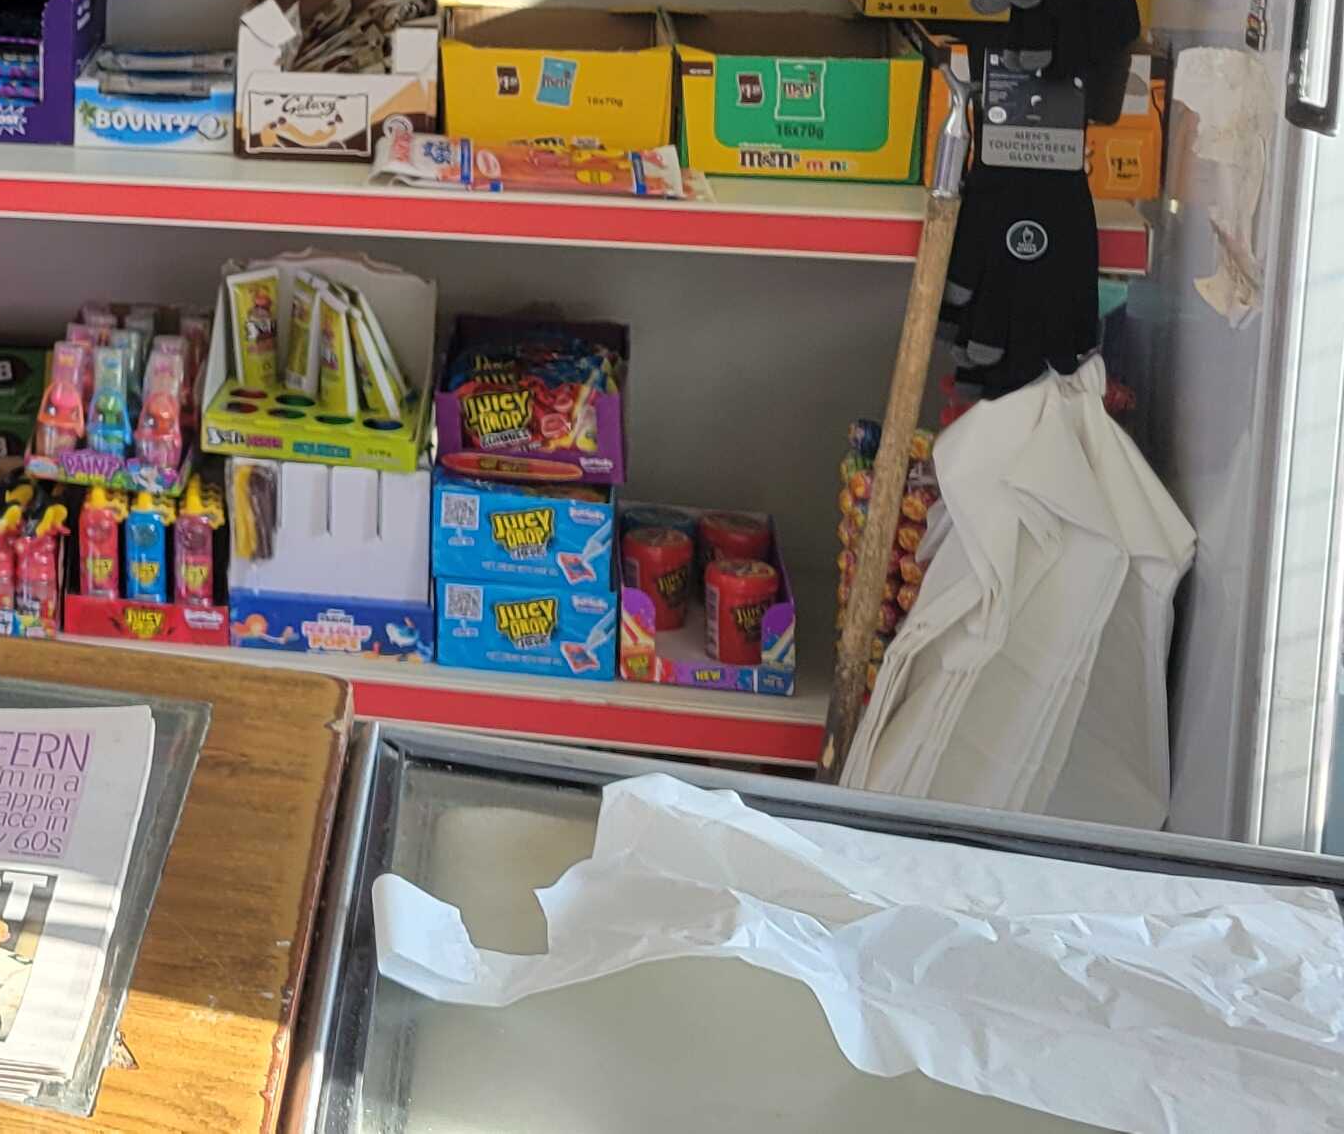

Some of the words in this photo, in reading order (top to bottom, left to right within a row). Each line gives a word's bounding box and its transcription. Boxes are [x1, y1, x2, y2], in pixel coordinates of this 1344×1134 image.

[94, 110, 198, 132] BOUNTY
[463, 390, 532, 423] JUICY
[491, 508, 555, 534] JUICY
[32, 770, 56, 791] in
[66, 776, 80, 792] a
[43, 811, 69, 833] in
[12, 830, 65, 854] 60s
